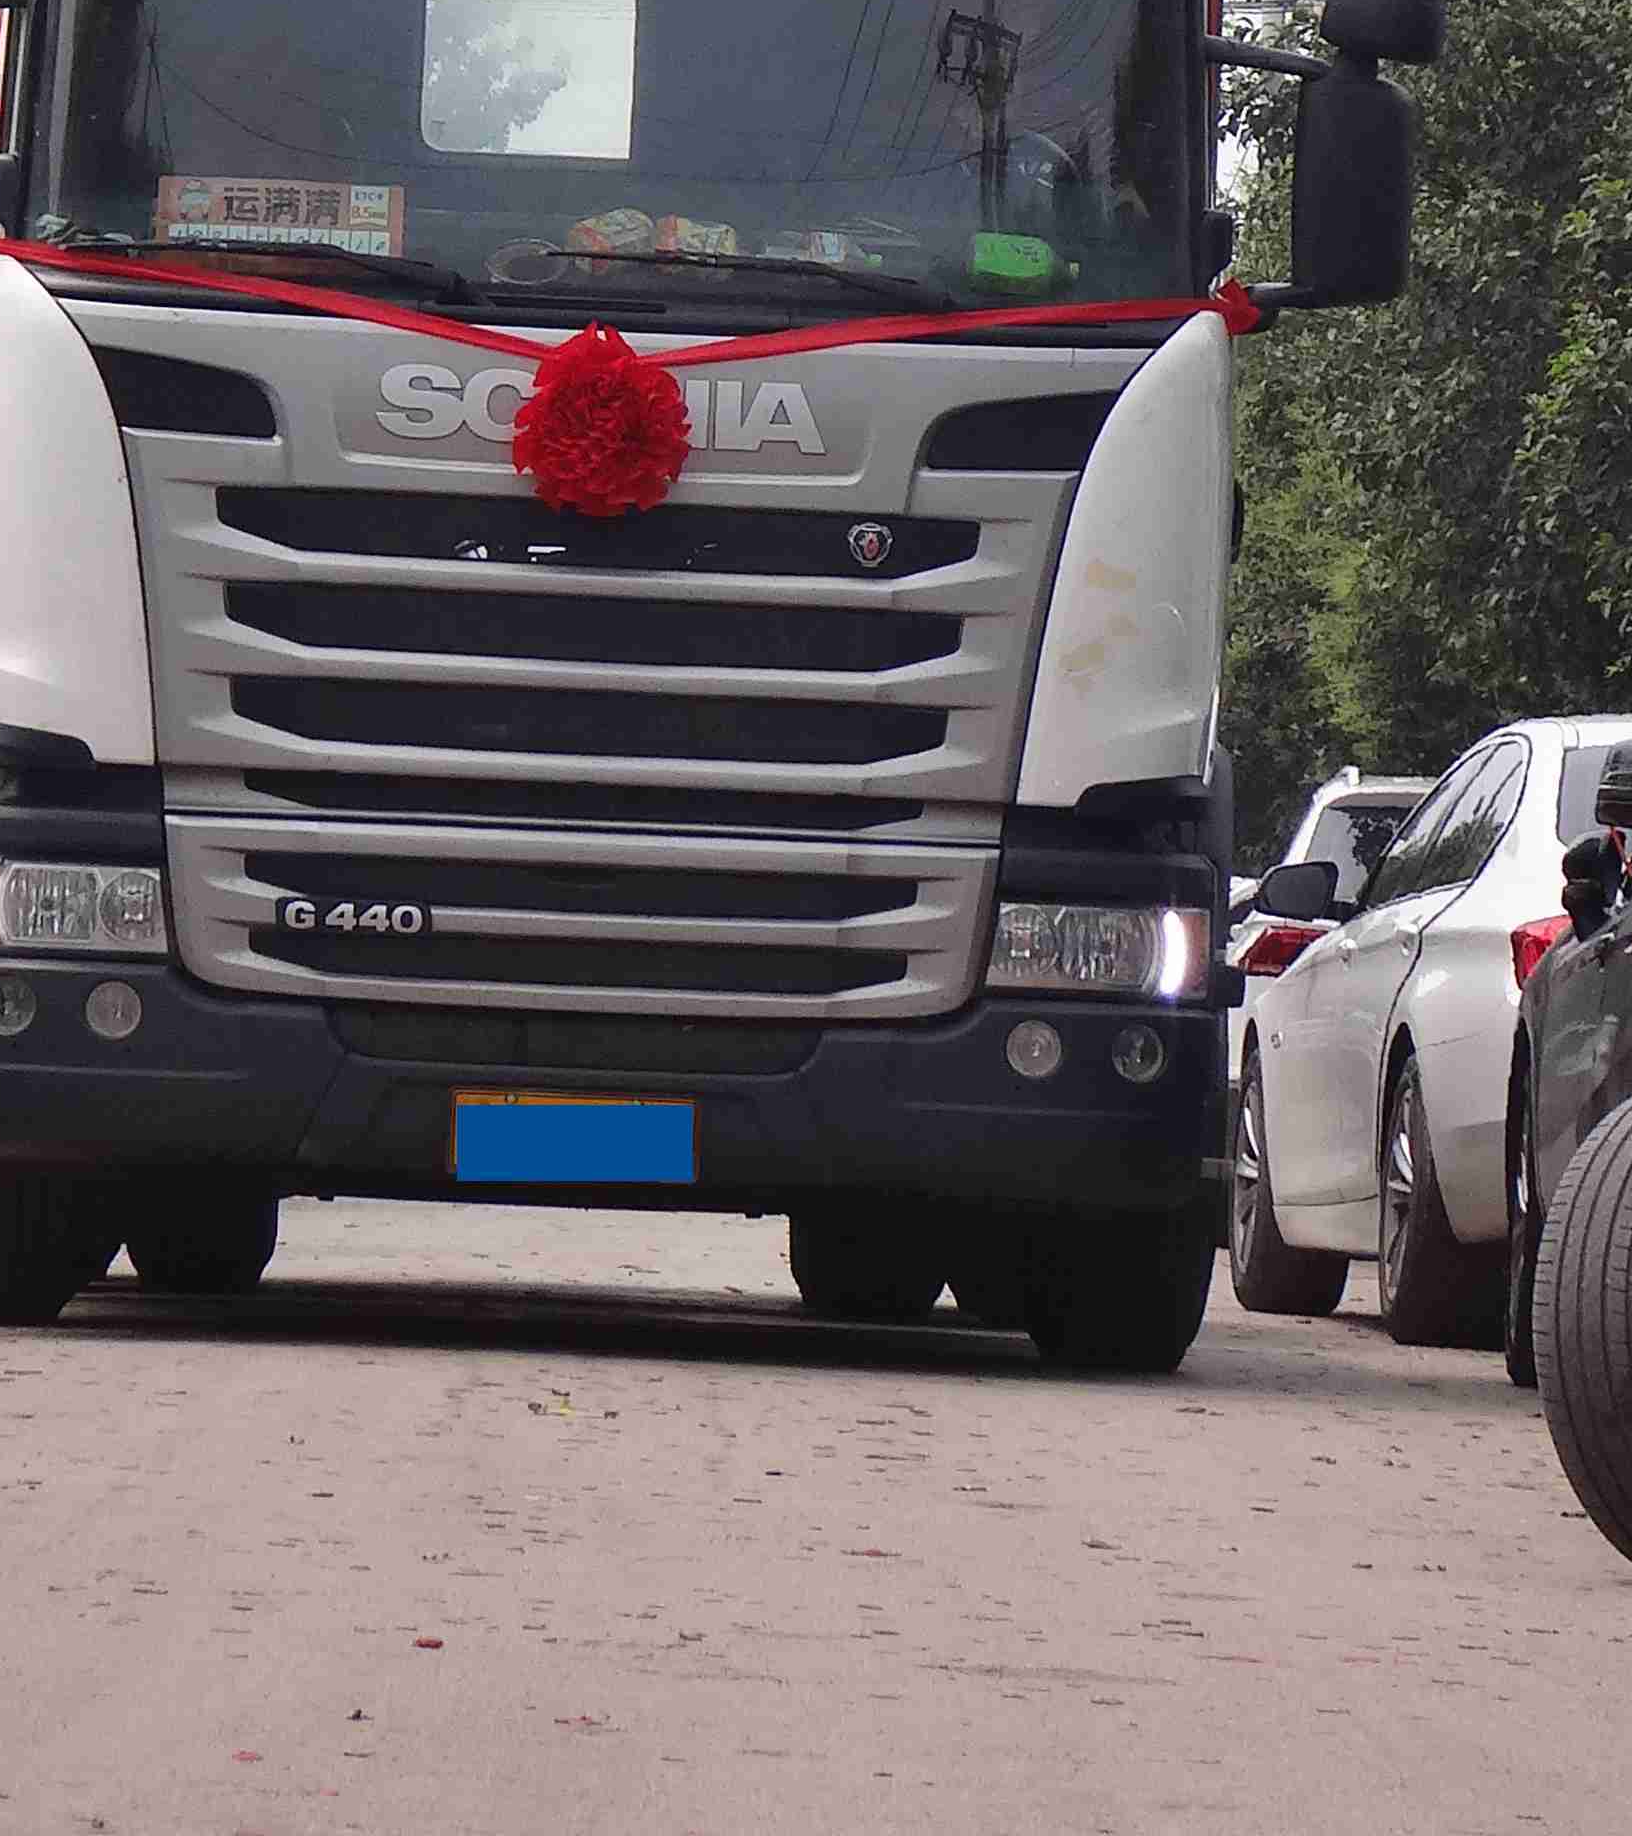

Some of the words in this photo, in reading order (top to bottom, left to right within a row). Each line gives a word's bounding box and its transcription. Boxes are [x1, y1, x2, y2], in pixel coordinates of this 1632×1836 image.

[223, 186, 341, 227] 运满满
[375, 363, 827, 456] SCIA
[284, 899, 316, 930] G
[325, 901, 423, 934] 440
